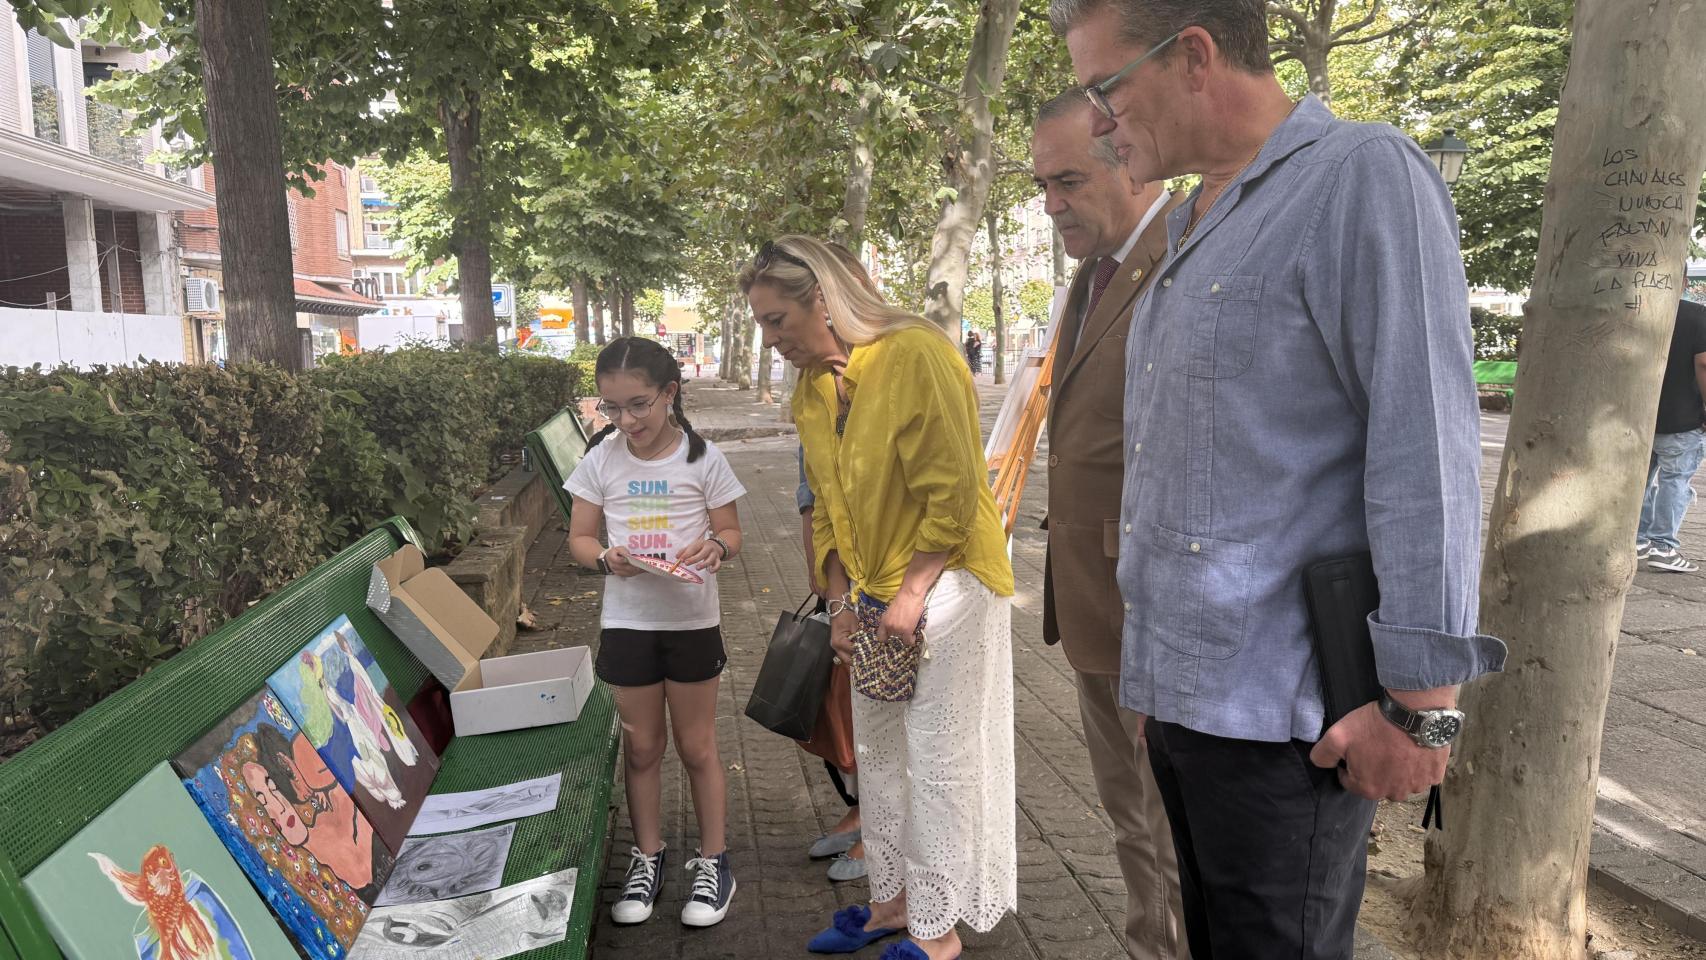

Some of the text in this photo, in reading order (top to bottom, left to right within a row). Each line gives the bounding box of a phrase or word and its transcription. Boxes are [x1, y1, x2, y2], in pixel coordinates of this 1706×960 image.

[1603, 148, 1639, 167] LOS
[1598, 217, 1671, 247] FALTAN
[1593, 277, 1622, 294] LA
[628, 480, 675, 496] SUN.
[627, 515, 675, 531] SUN.
[628, 533, 673, 550] SUN.
